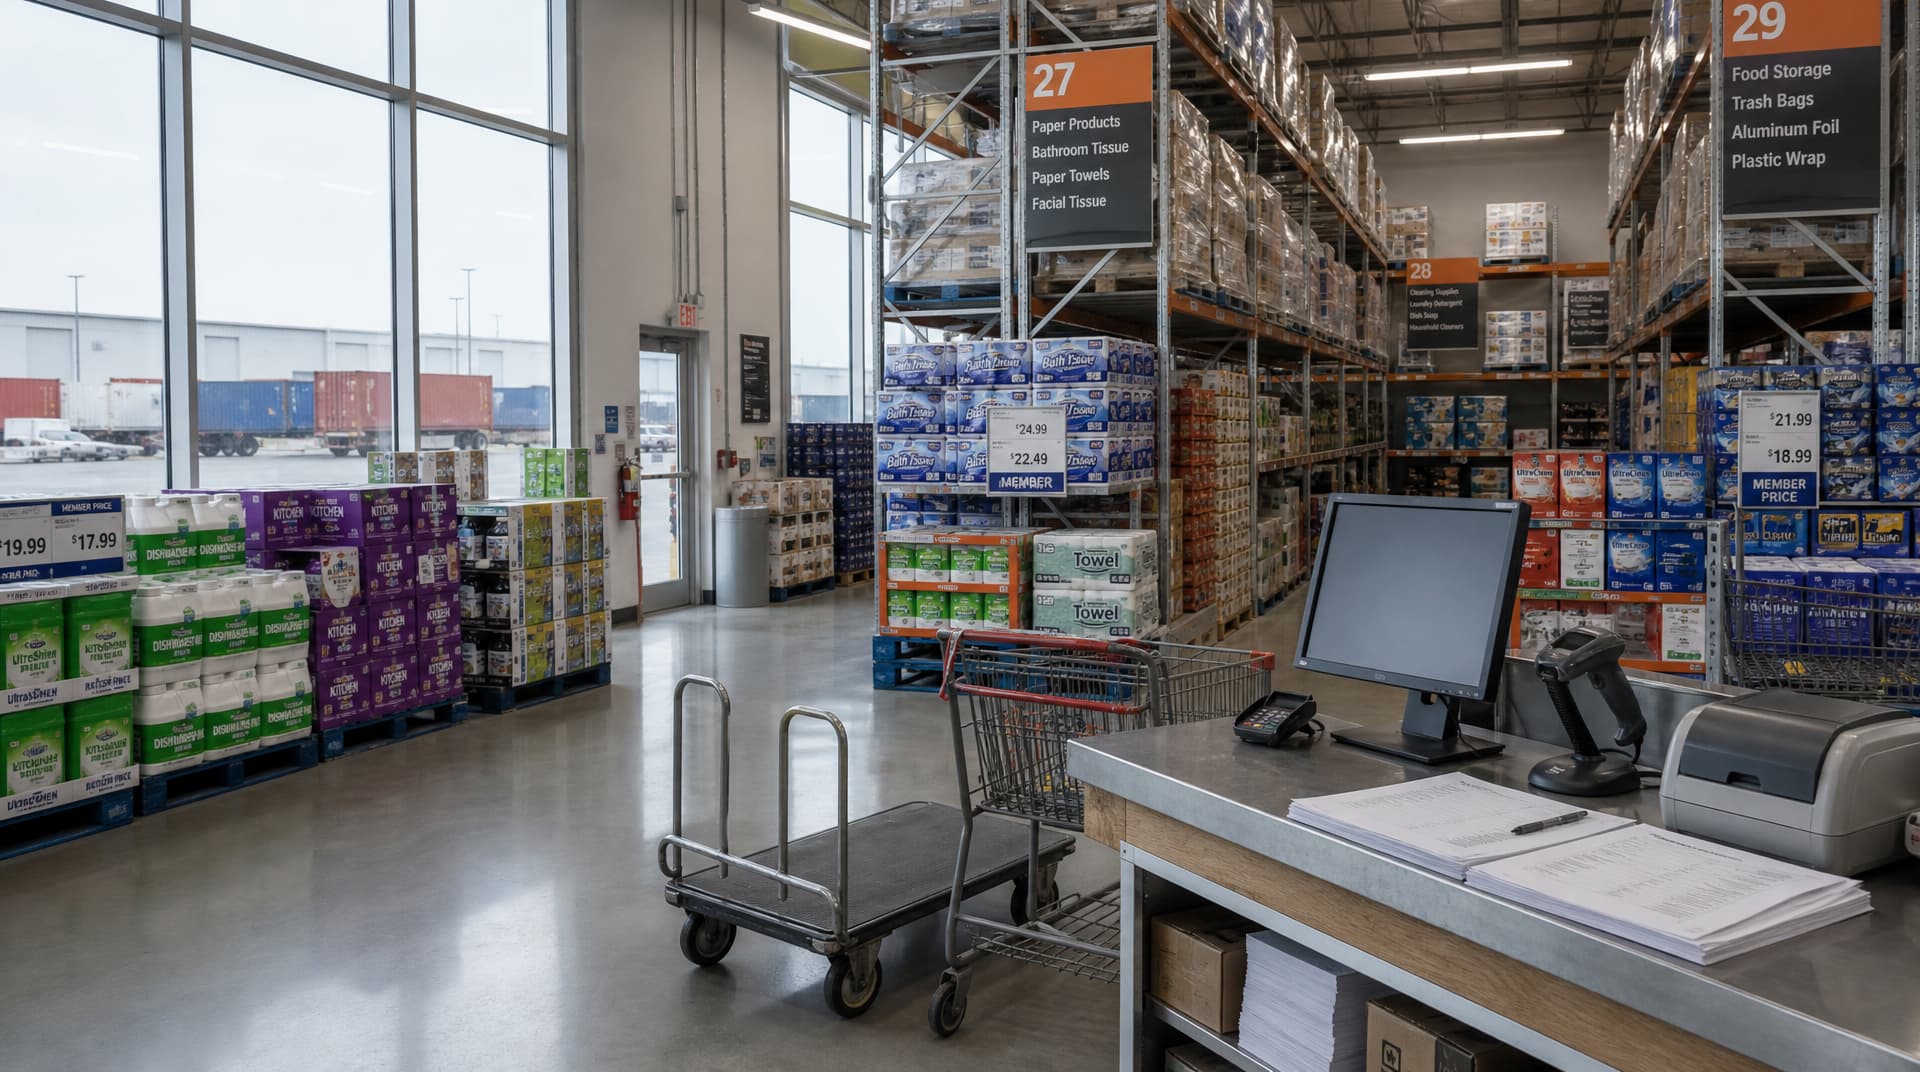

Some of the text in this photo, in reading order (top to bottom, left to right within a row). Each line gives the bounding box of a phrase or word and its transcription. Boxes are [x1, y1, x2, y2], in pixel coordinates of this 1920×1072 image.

[1732, 1, 1786, 42] 29
[1033, 62, 1075, 98] 27
[1732, 63, 1832, 82] Food Storage
[1732, 93, 1815, 110] Trash Bags
[1032, 115, 1121, 135] Paper Products
[1732, 119, 1840, 139] Aluminum Foil
[1032, 141, 1129, 159] Bathroom Tissue
[1732, 151, 1827, 169] Plastic Wrap
[1032, 168, 1110, 186] Paper Towels
[1032, 195, 1107, 211] Facial Tissue
[1410, 262, 1432, 279] 28
[680, 304, 697, 327] EXIT
[1770, 412, 1812, 427] $21.99
[1015, 423, 1047, 435] $24.99
[1010, 452, 1048, 465] $22.49
[1768, 449, 1812, 464] $18.99
[1752, 478, 1806, 490] MEMBER
[1761, 491, 1798, 502] PRICE
[93, 502, 113, 510] PRICE
[71, 532, 117, 550] $17.99
[1073, 552, 1119, 568] Towel
[1073, 604, 1119, 620] Towel
